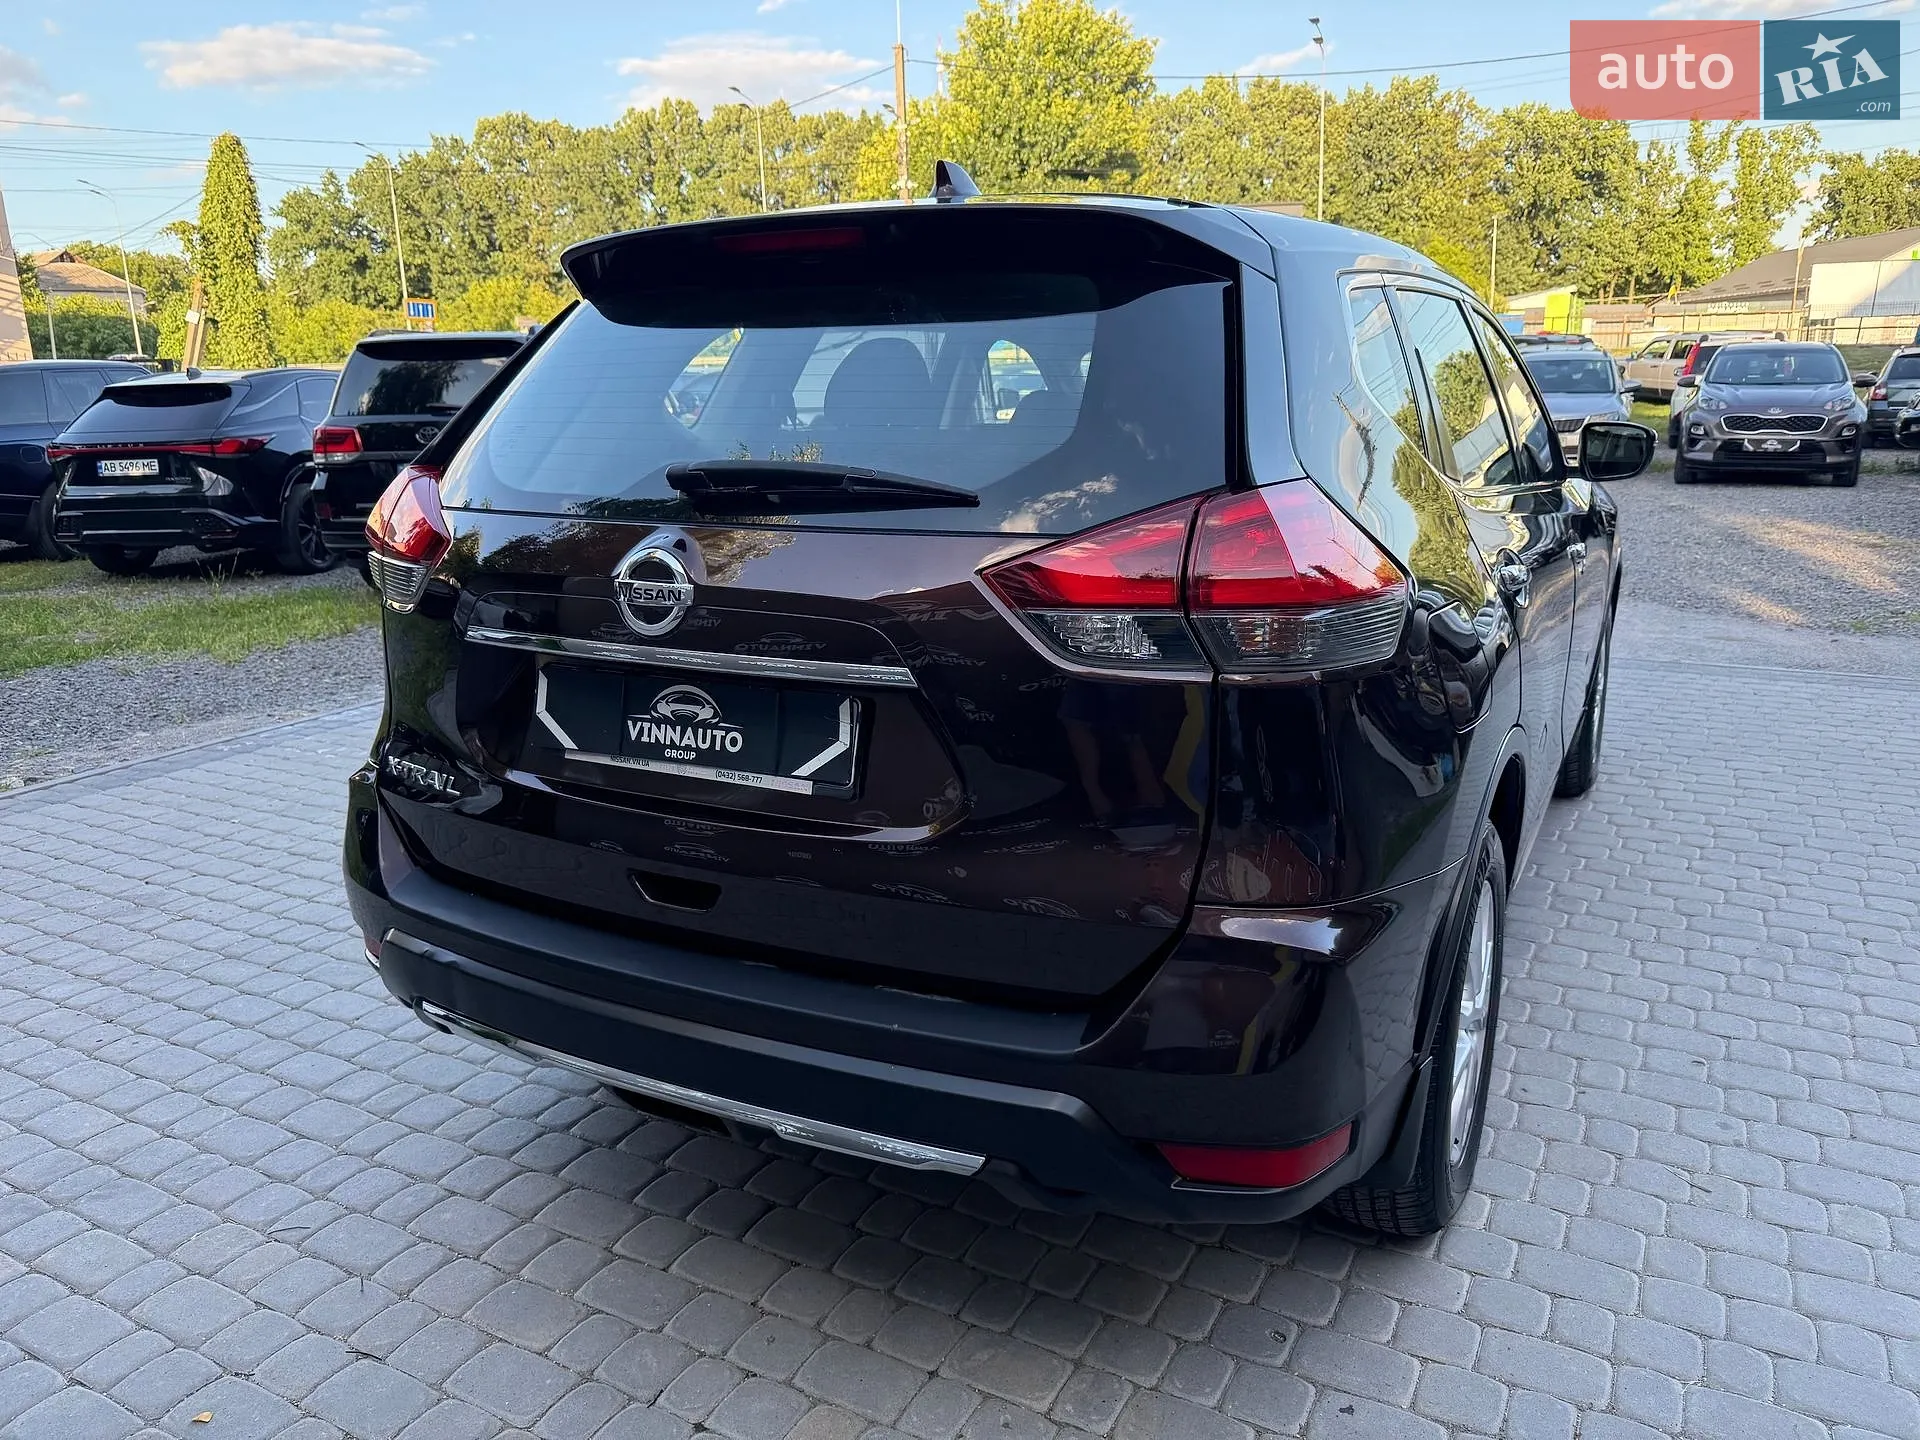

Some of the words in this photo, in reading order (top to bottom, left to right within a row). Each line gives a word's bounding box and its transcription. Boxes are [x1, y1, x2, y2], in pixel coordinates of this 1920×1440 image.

[103, 462, 116, 472] AB
[118, 461, 140, 472] 5496
[142, 460, 157, 471] ME
[618, 584, 682, 602] NISSAN
[627, 719, 744, 753] VINNAUTO
[664, 748, 696, 761] GROUP
[715, 769, 736, 781] (0432)
